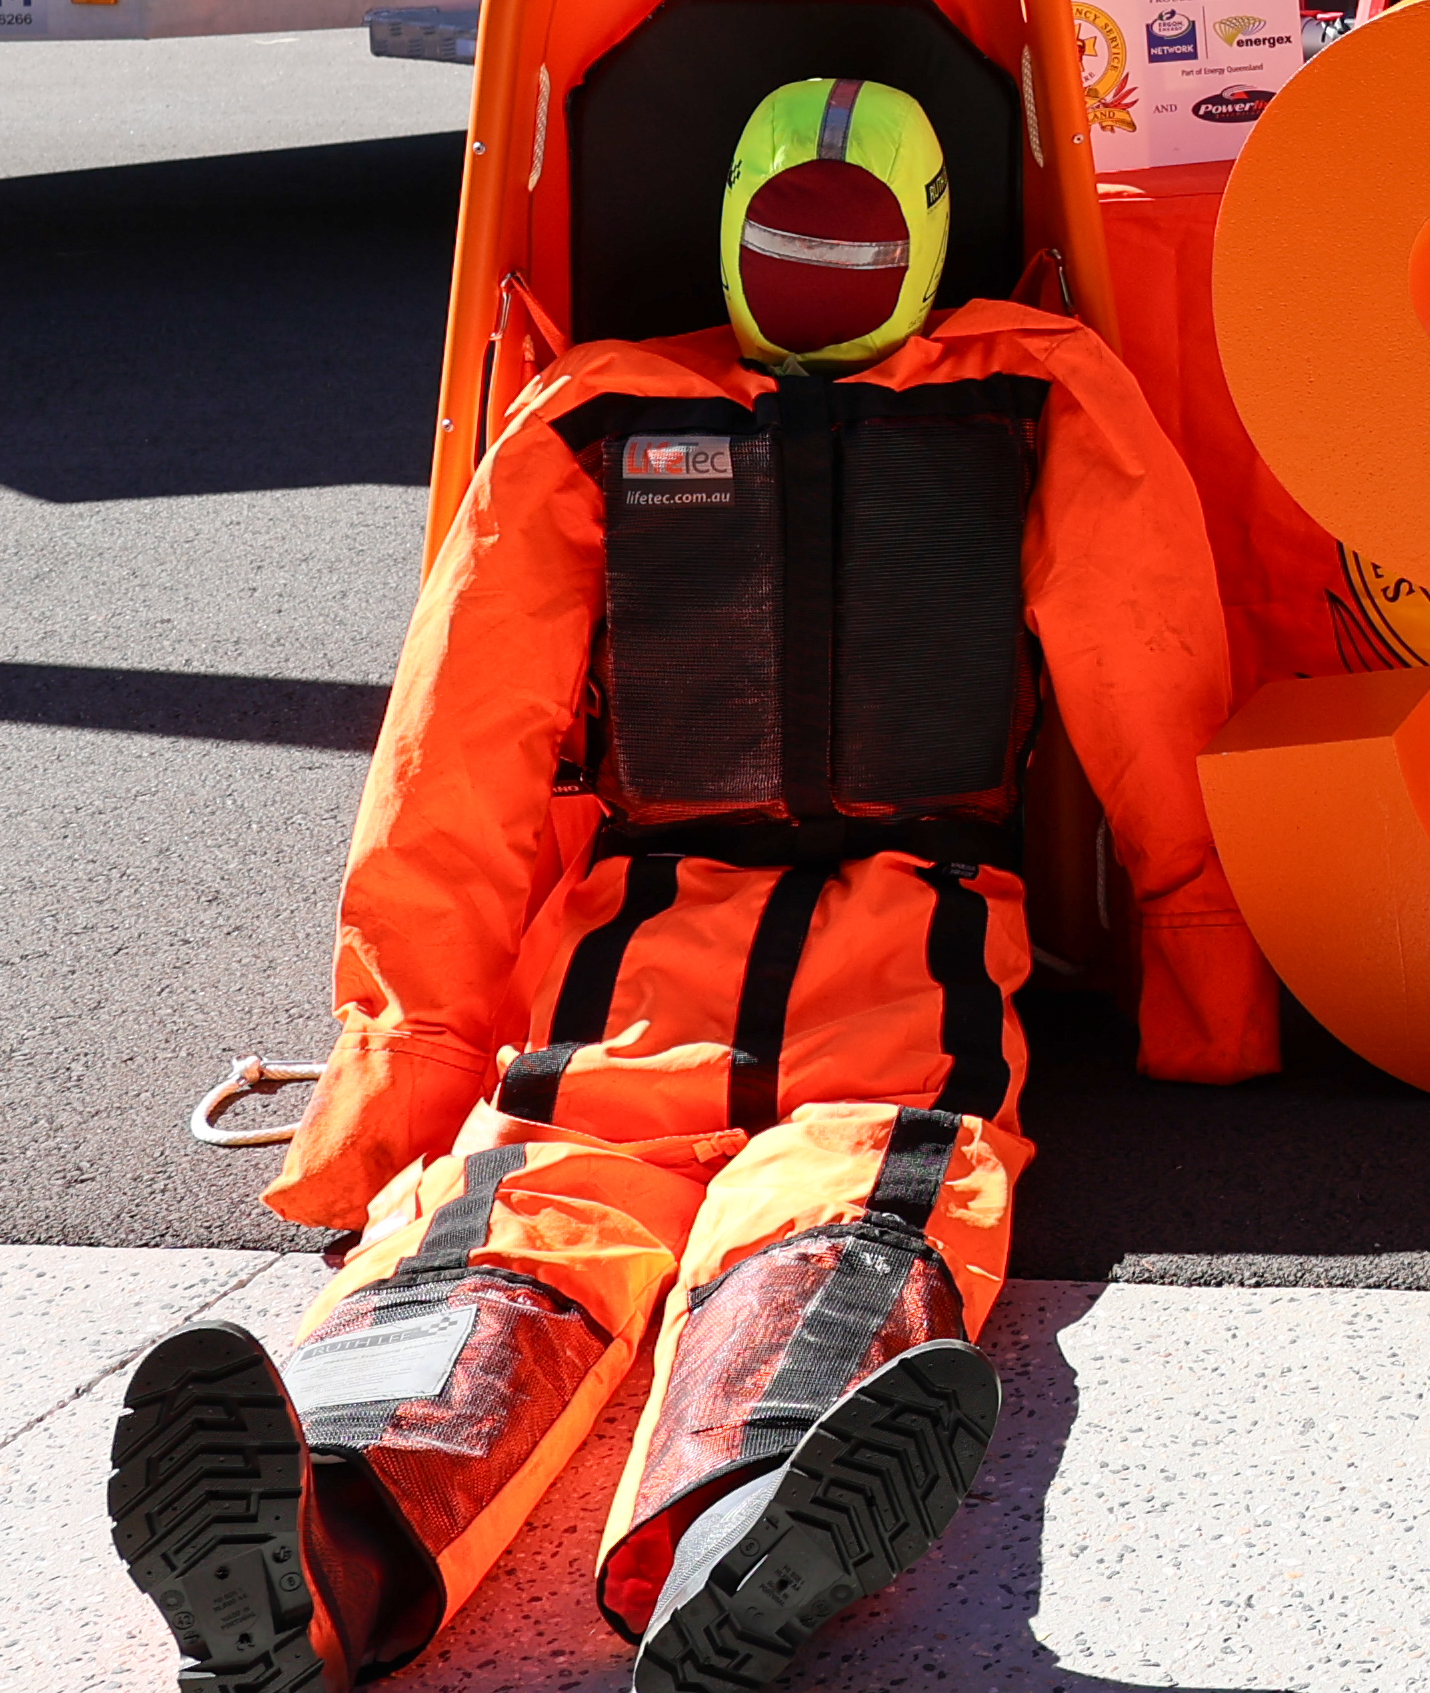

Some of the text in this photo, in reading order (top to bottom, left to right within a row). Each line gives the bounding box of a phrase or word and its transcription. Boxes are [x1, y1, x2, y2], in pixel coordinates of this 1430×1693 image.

[1236, 35, 1292, 48] energex
[1150, 44, 1194, 55] NETWORK
[1181, 69, 1194, 77] Part
[1204, 67, 1225, 77] Energy
[1227, 63, 1264, 73] Queensland
[1153, 104, 1178, 114] AND
[1198, 97, 1268, 116] Powerli
[627, 441, 728, 474] LifeTec
[626, 490, 730, 505] lifetec.com.au
[312, 1330, 411, 1356] RUTH LEE
